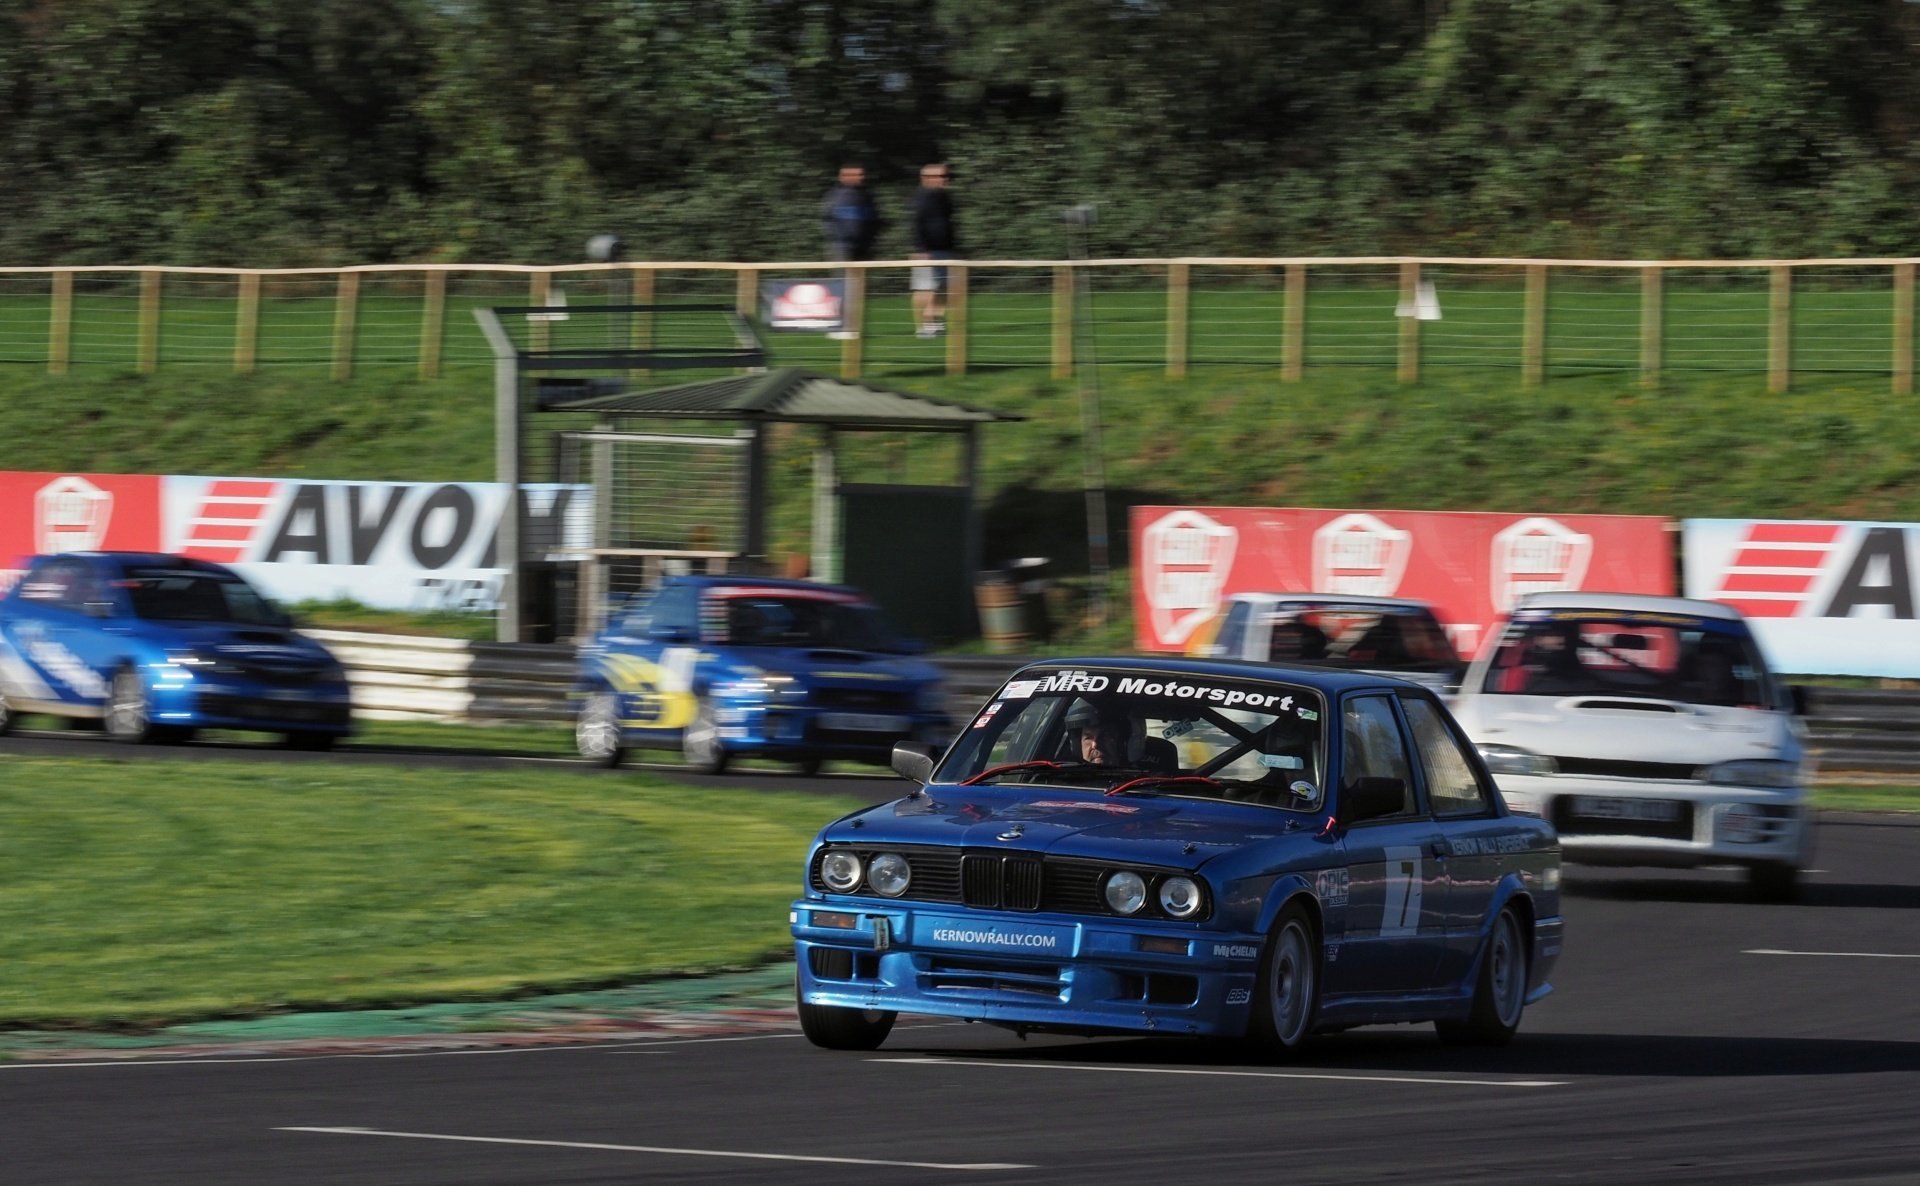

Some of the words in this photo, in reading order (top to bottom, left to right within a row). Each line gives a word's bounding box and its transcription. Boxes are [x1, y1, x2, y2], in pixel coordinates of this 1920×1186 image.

[1042, 676, 1109, 692] MRD
[1116, 678, 1294, 710] Motorsport
[1318, 870, 1349, 898] OPIE
[1401, 862, 1414, 927] 7
[933, 929, 1056, 947] KERNOWRALLY.COM
